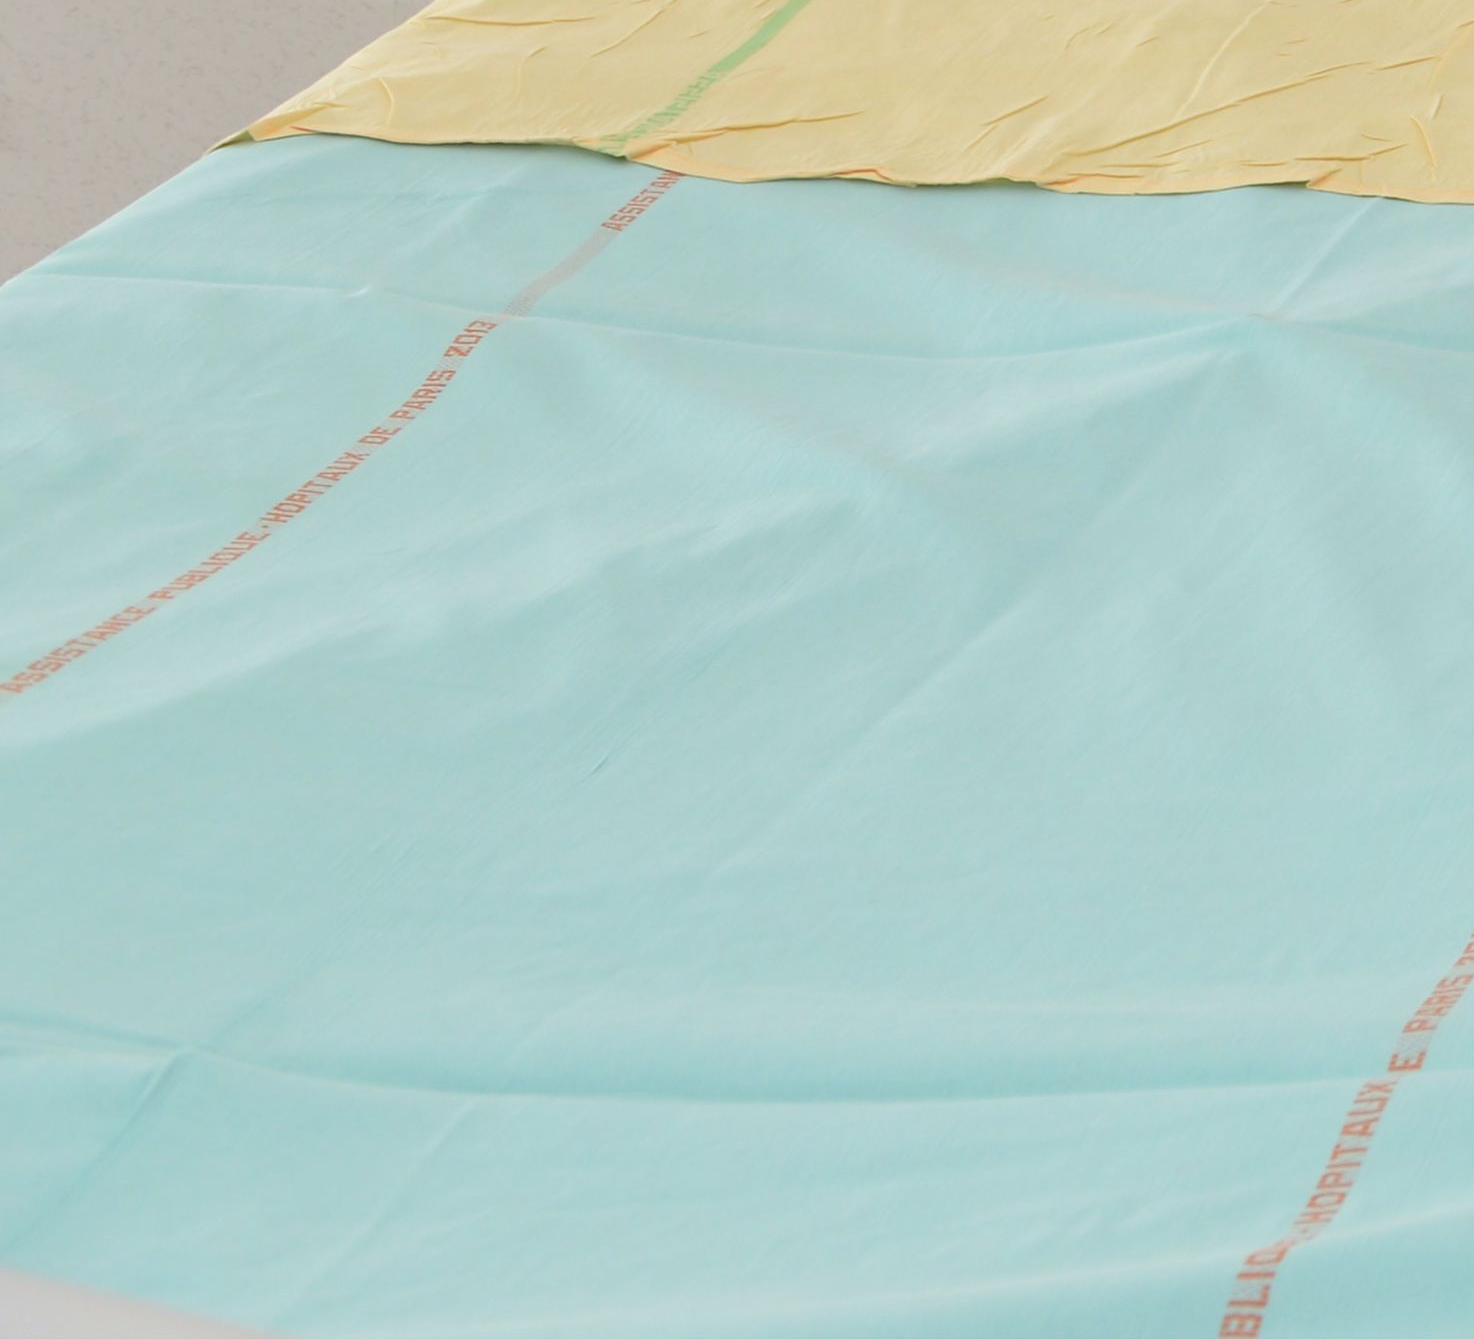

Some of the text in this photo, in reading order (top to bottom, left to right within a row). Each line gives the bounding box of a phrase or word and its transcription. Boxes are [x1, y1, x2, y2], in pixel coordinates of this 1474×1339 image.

[600, 171, 685, 231] ASSISTAN
[0, 606, 157, 694] ASSISTANCE
[357, 426, 402, 445] DE
[389, 370, 456, 420] PARIS
[1402, 973, 1474, 1033] PARIS
[1387, 1051, 1426, 1073] E
